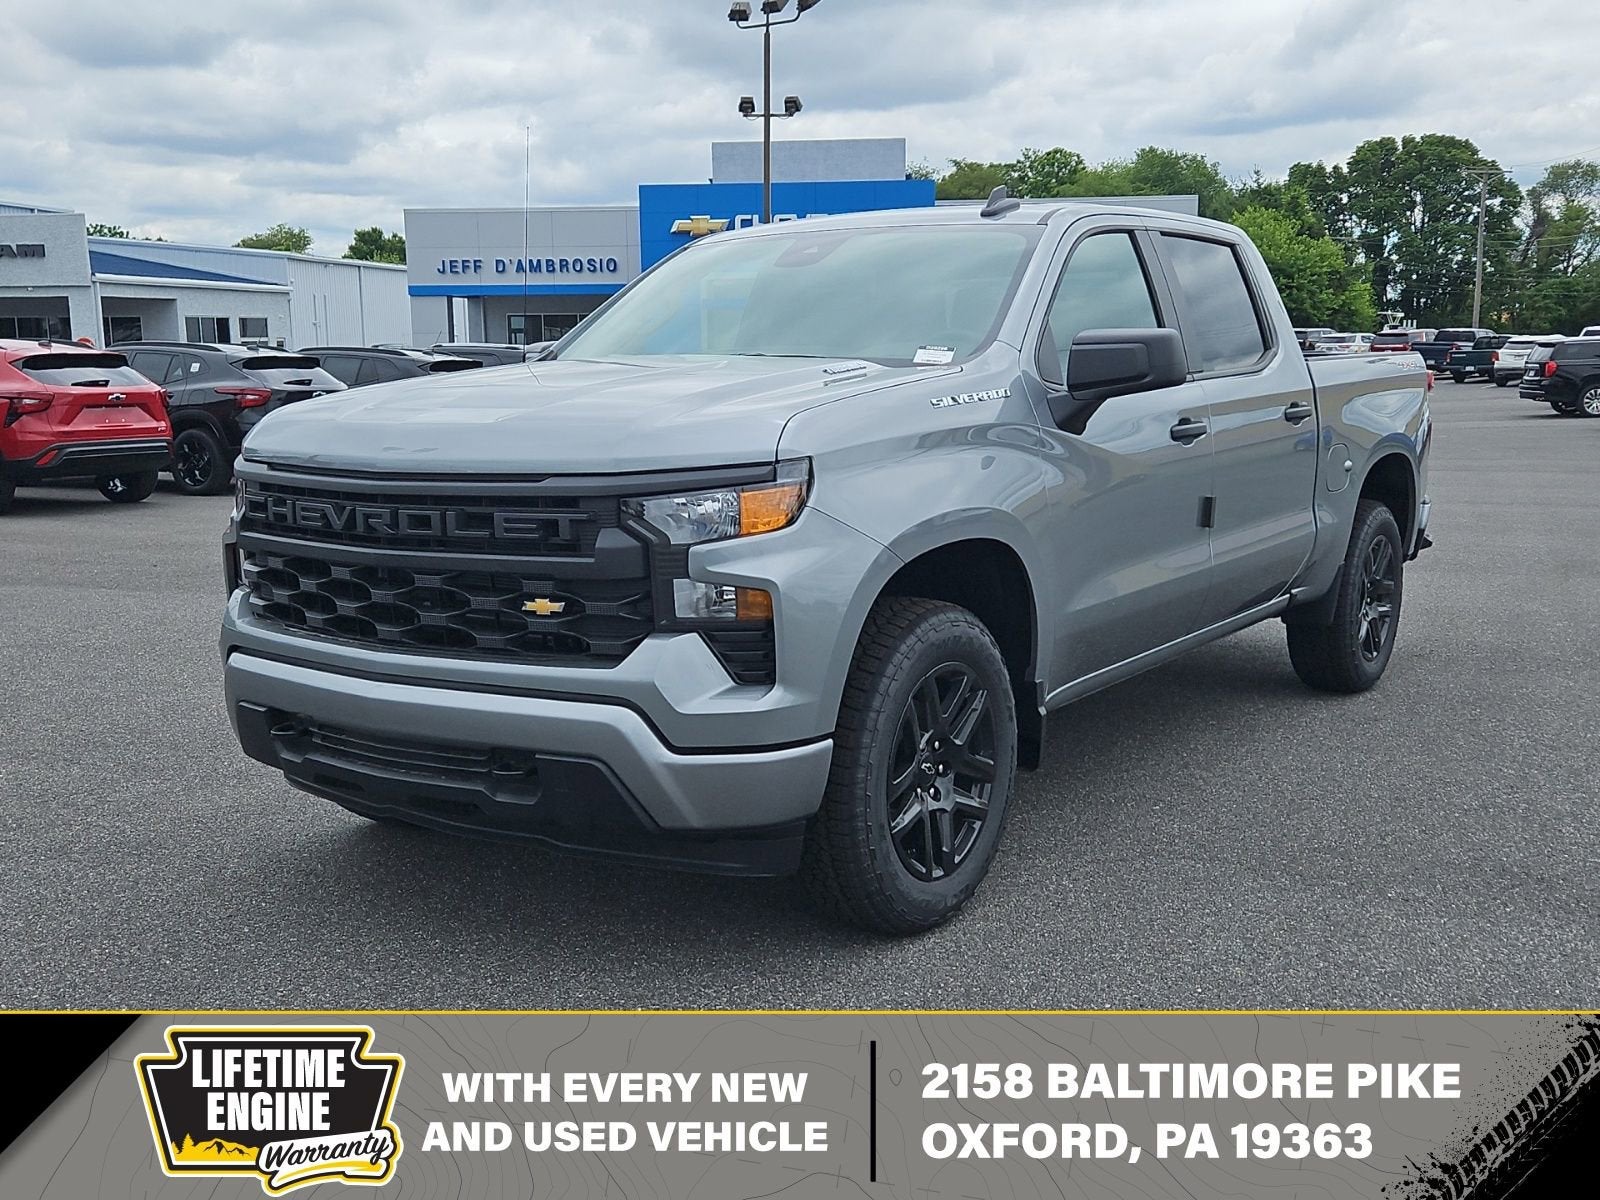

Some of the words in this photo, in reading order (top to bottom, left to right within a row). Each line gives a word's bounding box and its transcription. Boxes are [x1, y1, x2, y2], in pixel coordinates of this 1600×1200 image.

[437, 259, 482, 275] JEFF
[495, 258, 618, 275] D'AMBROSIO
[930, 388, 1011, 409] SILVERADO
[245, 493, 592, 541] CHEVROLET
